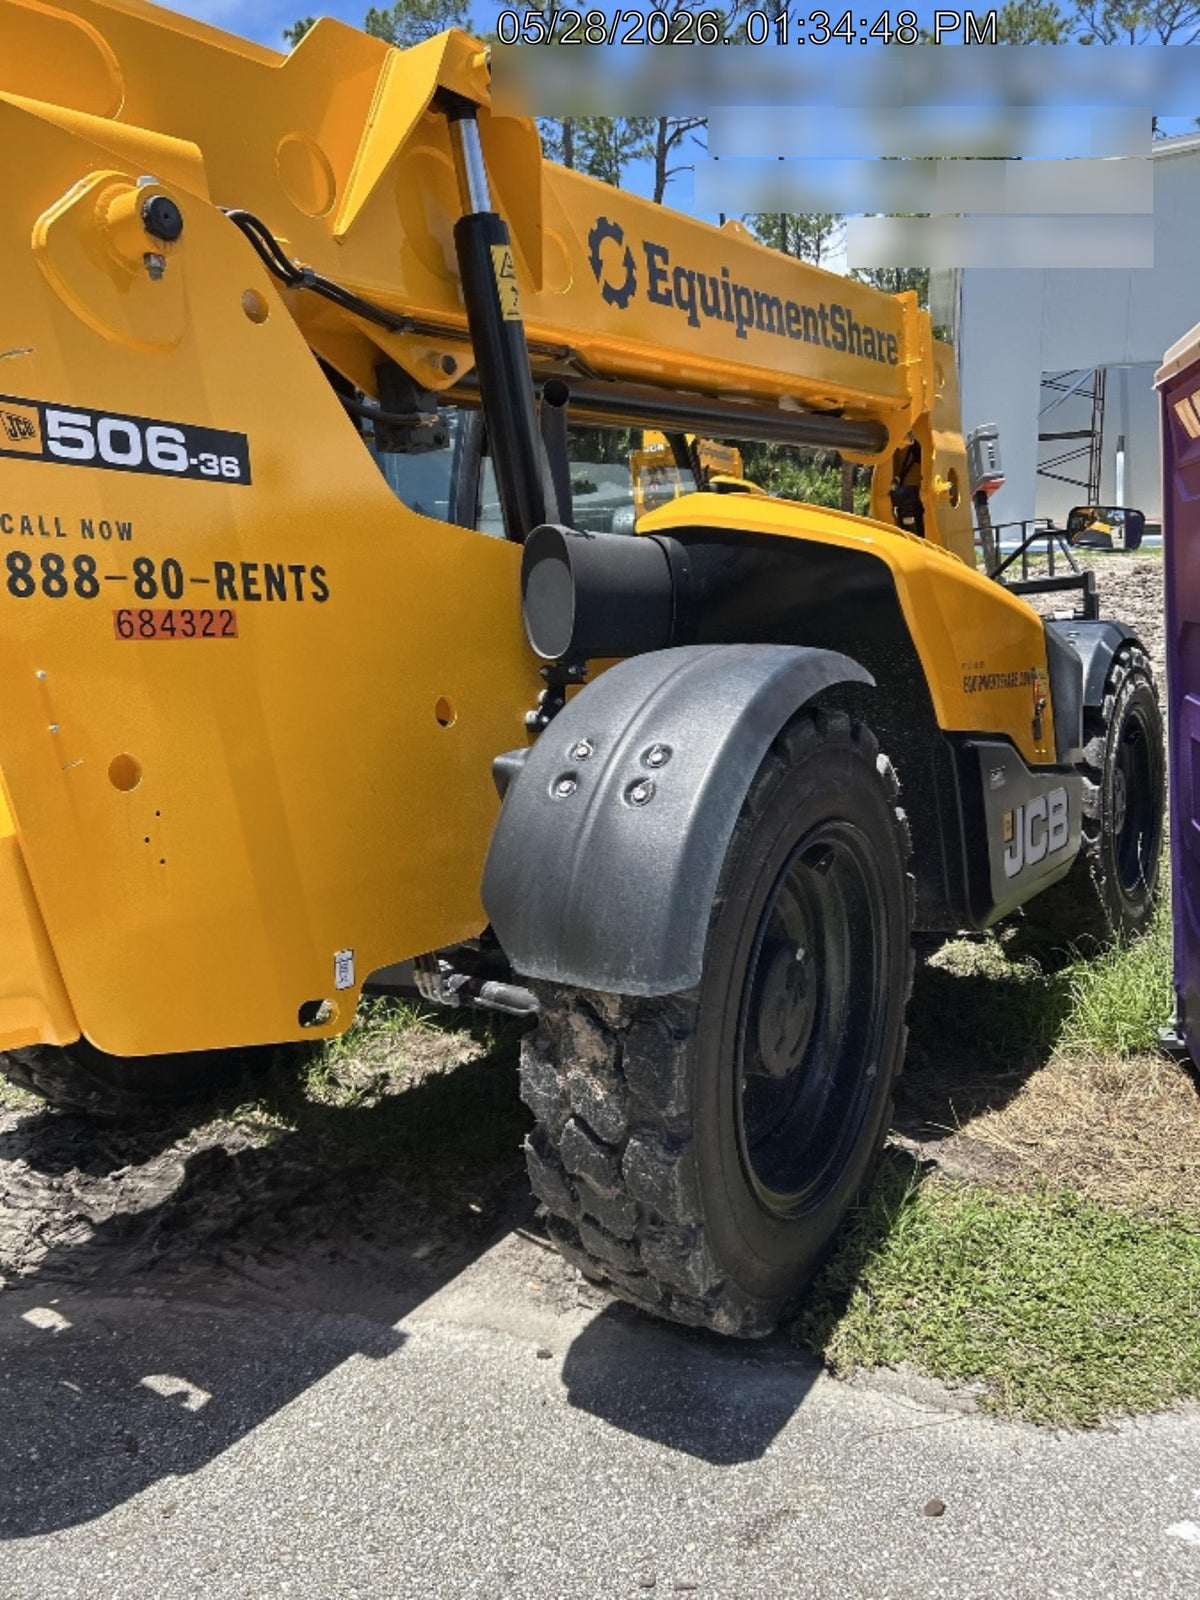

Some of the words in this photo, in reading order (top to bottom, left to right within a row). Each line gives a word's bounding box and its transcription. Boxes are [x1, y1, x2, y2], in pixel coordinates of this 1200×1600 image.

[642, 240, 900, 365] EquipmentShare
[0, 514, 67, 538] CALL
[80, 518, 133, 541] NOW
[6, 551, 330, 603] 888-80-RENTS
[116, 609, 236, 638] 684322
[1003, 786, 1069, 878] JCB
